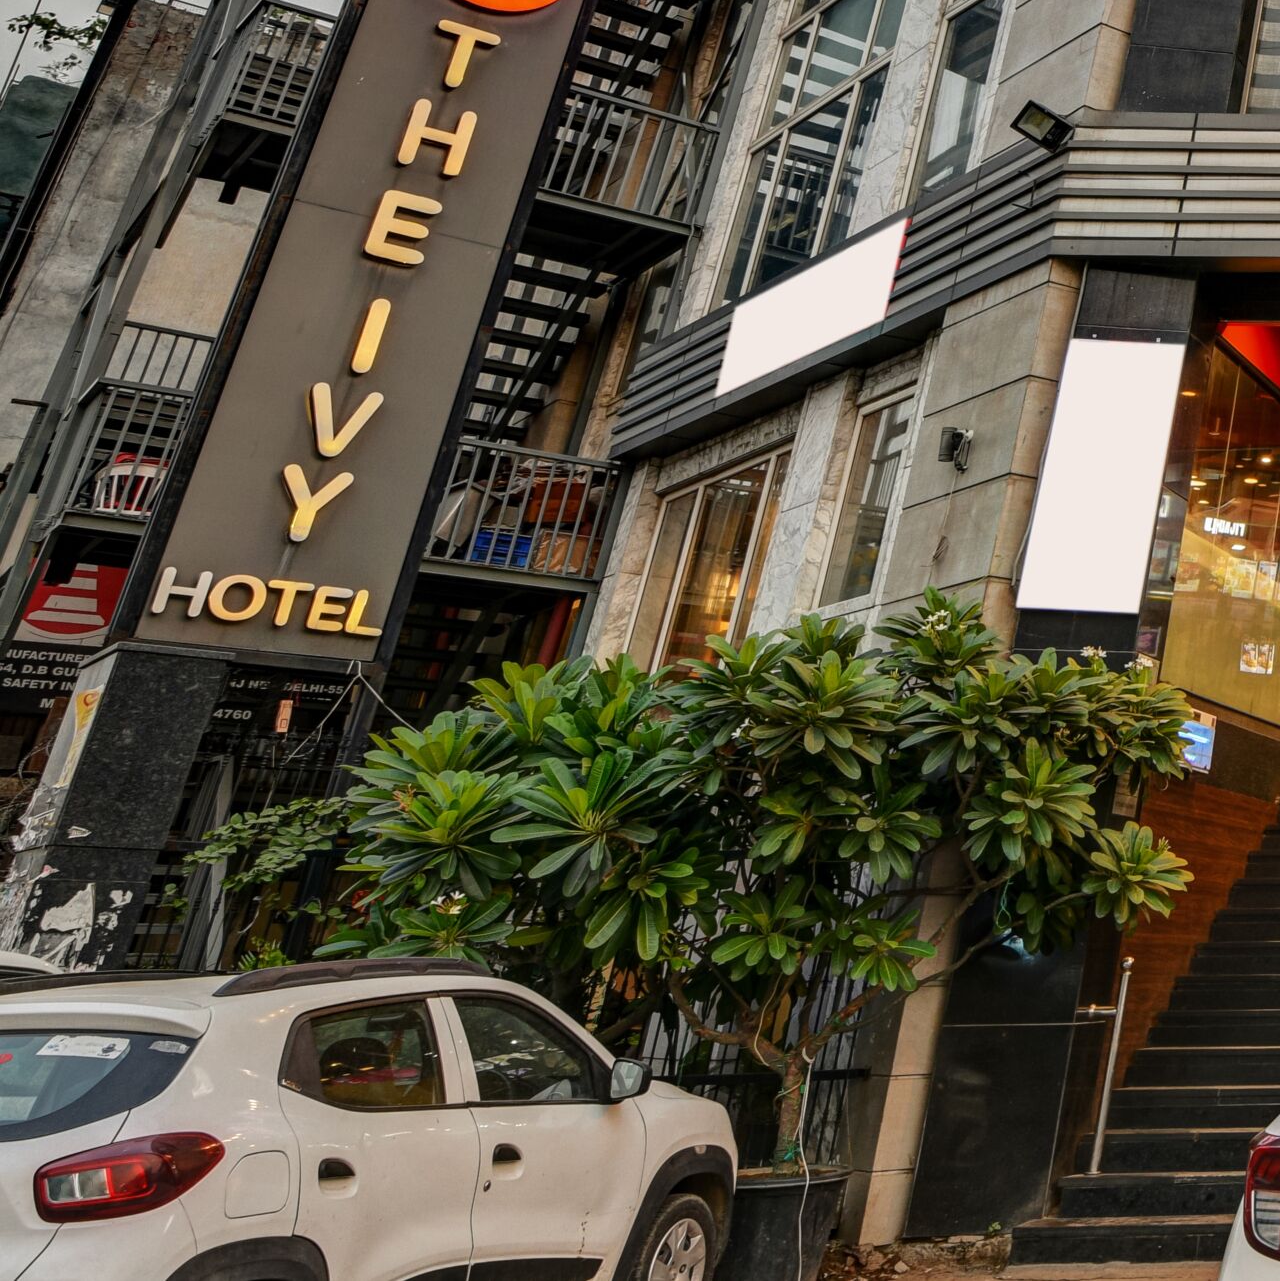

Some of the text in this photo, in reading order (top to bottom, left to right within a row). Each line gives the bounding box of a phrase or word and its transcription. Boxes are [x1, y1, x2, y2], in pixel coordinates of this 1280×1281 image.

[282, 19, 502, 543] THE IVY
[150, 565, 382, 638] HOTEL
[2, 678, 58, 690] SAFETY
